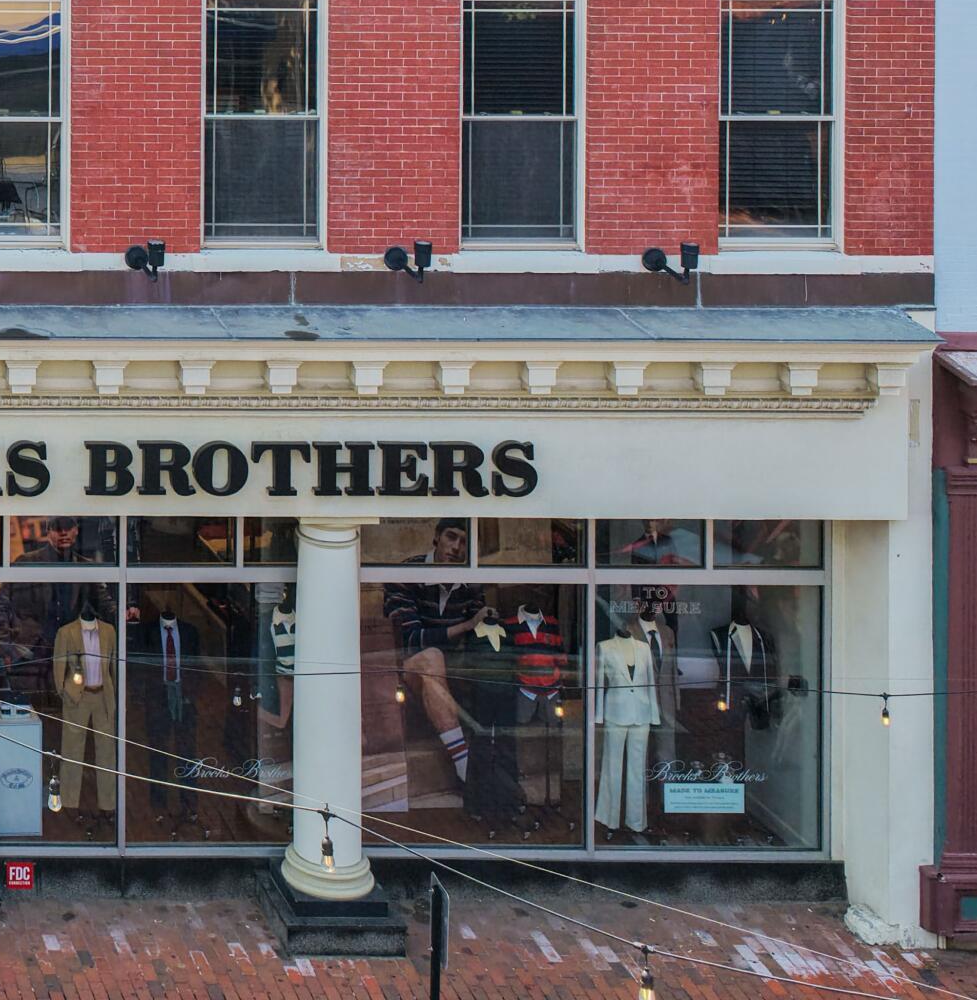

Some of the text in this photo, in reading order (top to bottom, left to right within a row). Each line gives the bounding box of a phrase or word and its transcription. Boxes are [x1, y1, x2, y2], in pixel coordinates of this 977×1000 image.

[84, 439, 538, 497] BROTHERS
[642, 586, 669, 600] TO
[645, 760, 699, 781] Brooks
[9, 866, 31, 881] FDC
